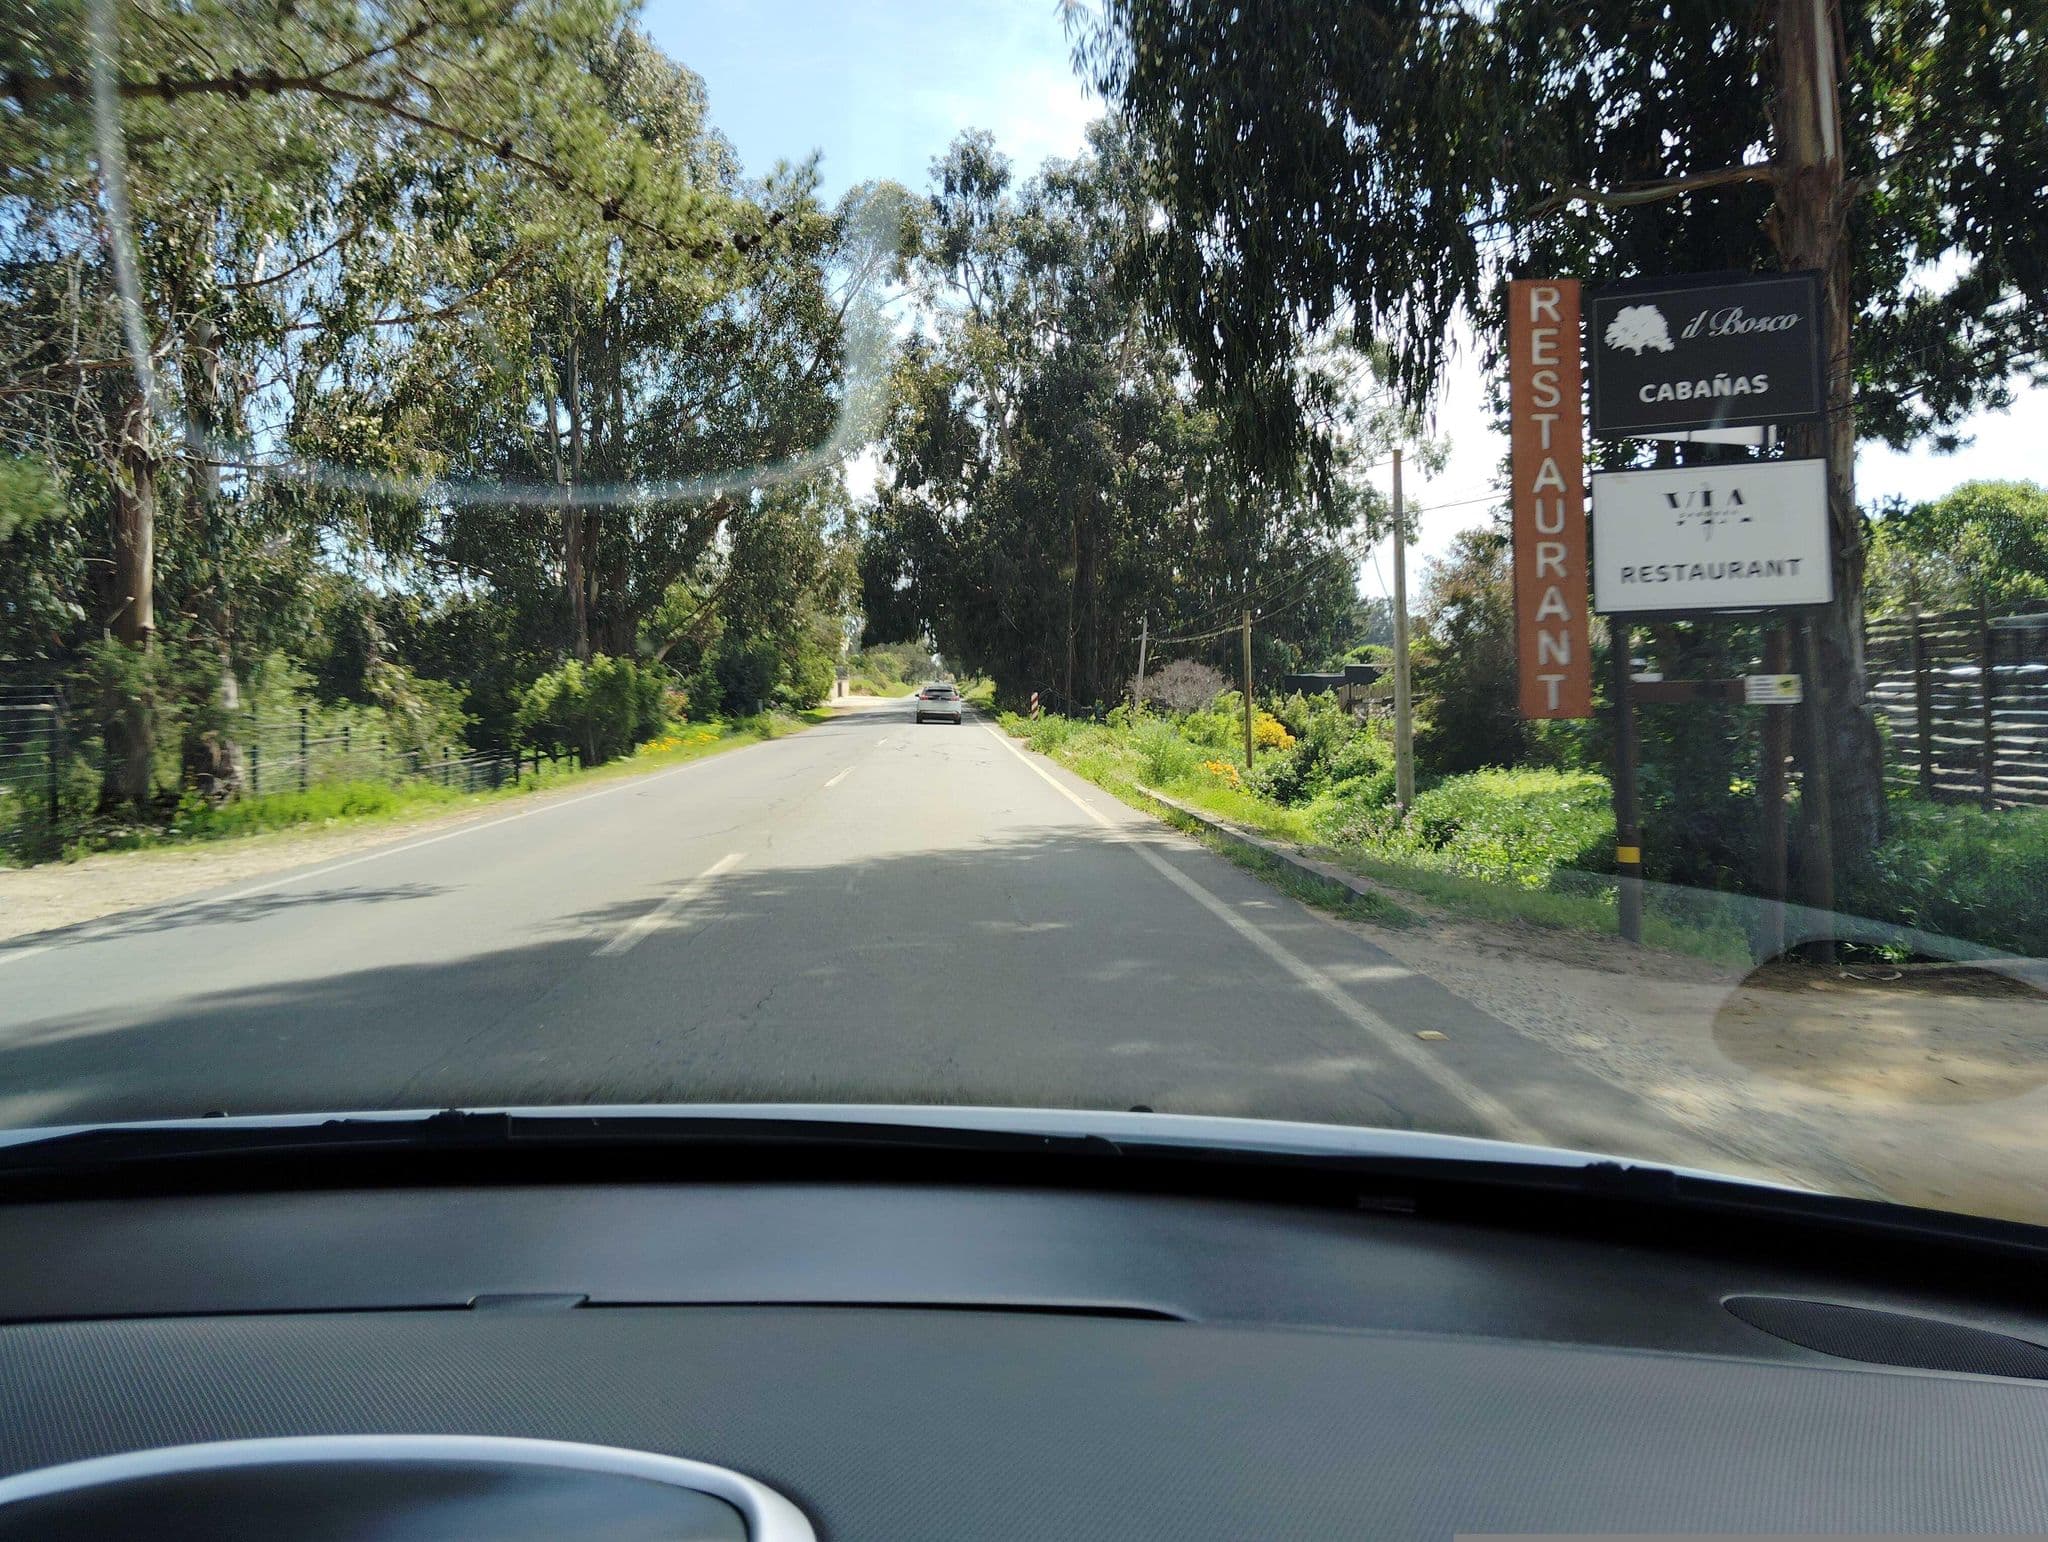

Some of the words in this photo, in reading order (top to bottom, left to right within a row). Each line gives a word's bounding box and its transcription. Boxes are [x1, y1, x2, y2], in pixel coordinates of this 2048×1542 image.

[1708, 305, 1804, 337] Bosco
[1639, 372, 1769, 403] CABAÑAS
[1529, 286, 1572, 711] RESTAURANT
[1620, 557, 1803, 585] RESTAURANT
